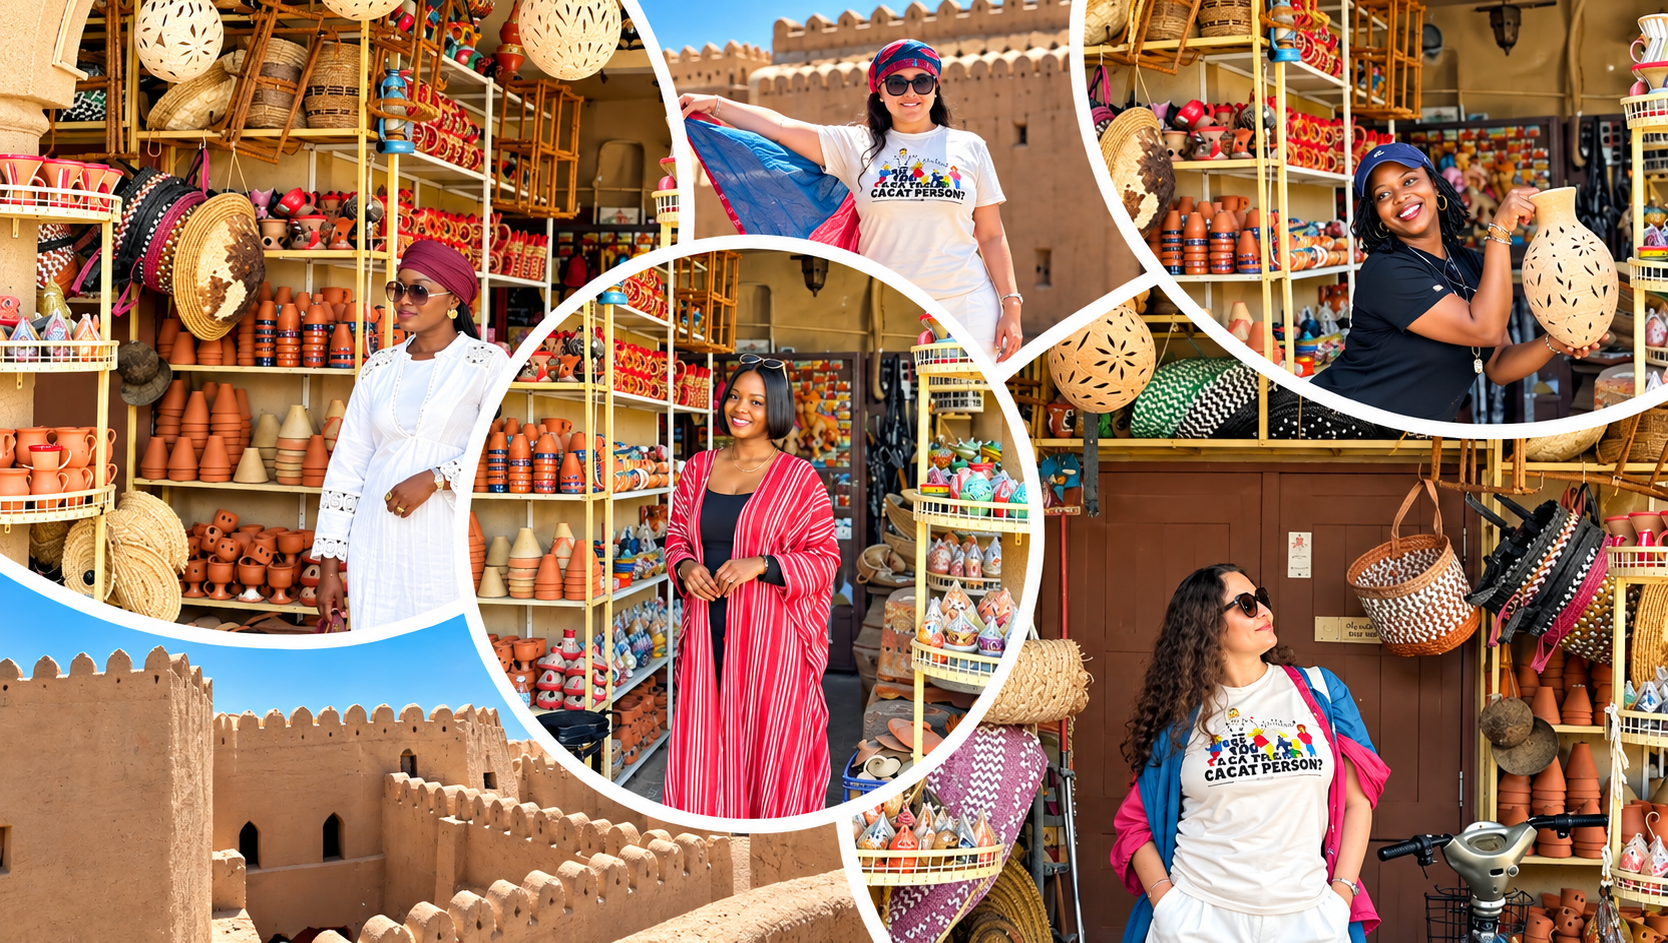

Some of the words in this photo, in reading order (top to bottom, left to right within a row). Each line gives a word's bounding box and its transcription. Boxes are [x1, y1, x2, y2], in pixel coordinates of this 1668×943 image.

[871, 188, 913, 198] CACAT
[914, 188, 966, 200] PERSON?
[1204, 764, 1258, 782] CACAT
[1261, 758, 1323, 775] PERSON?
